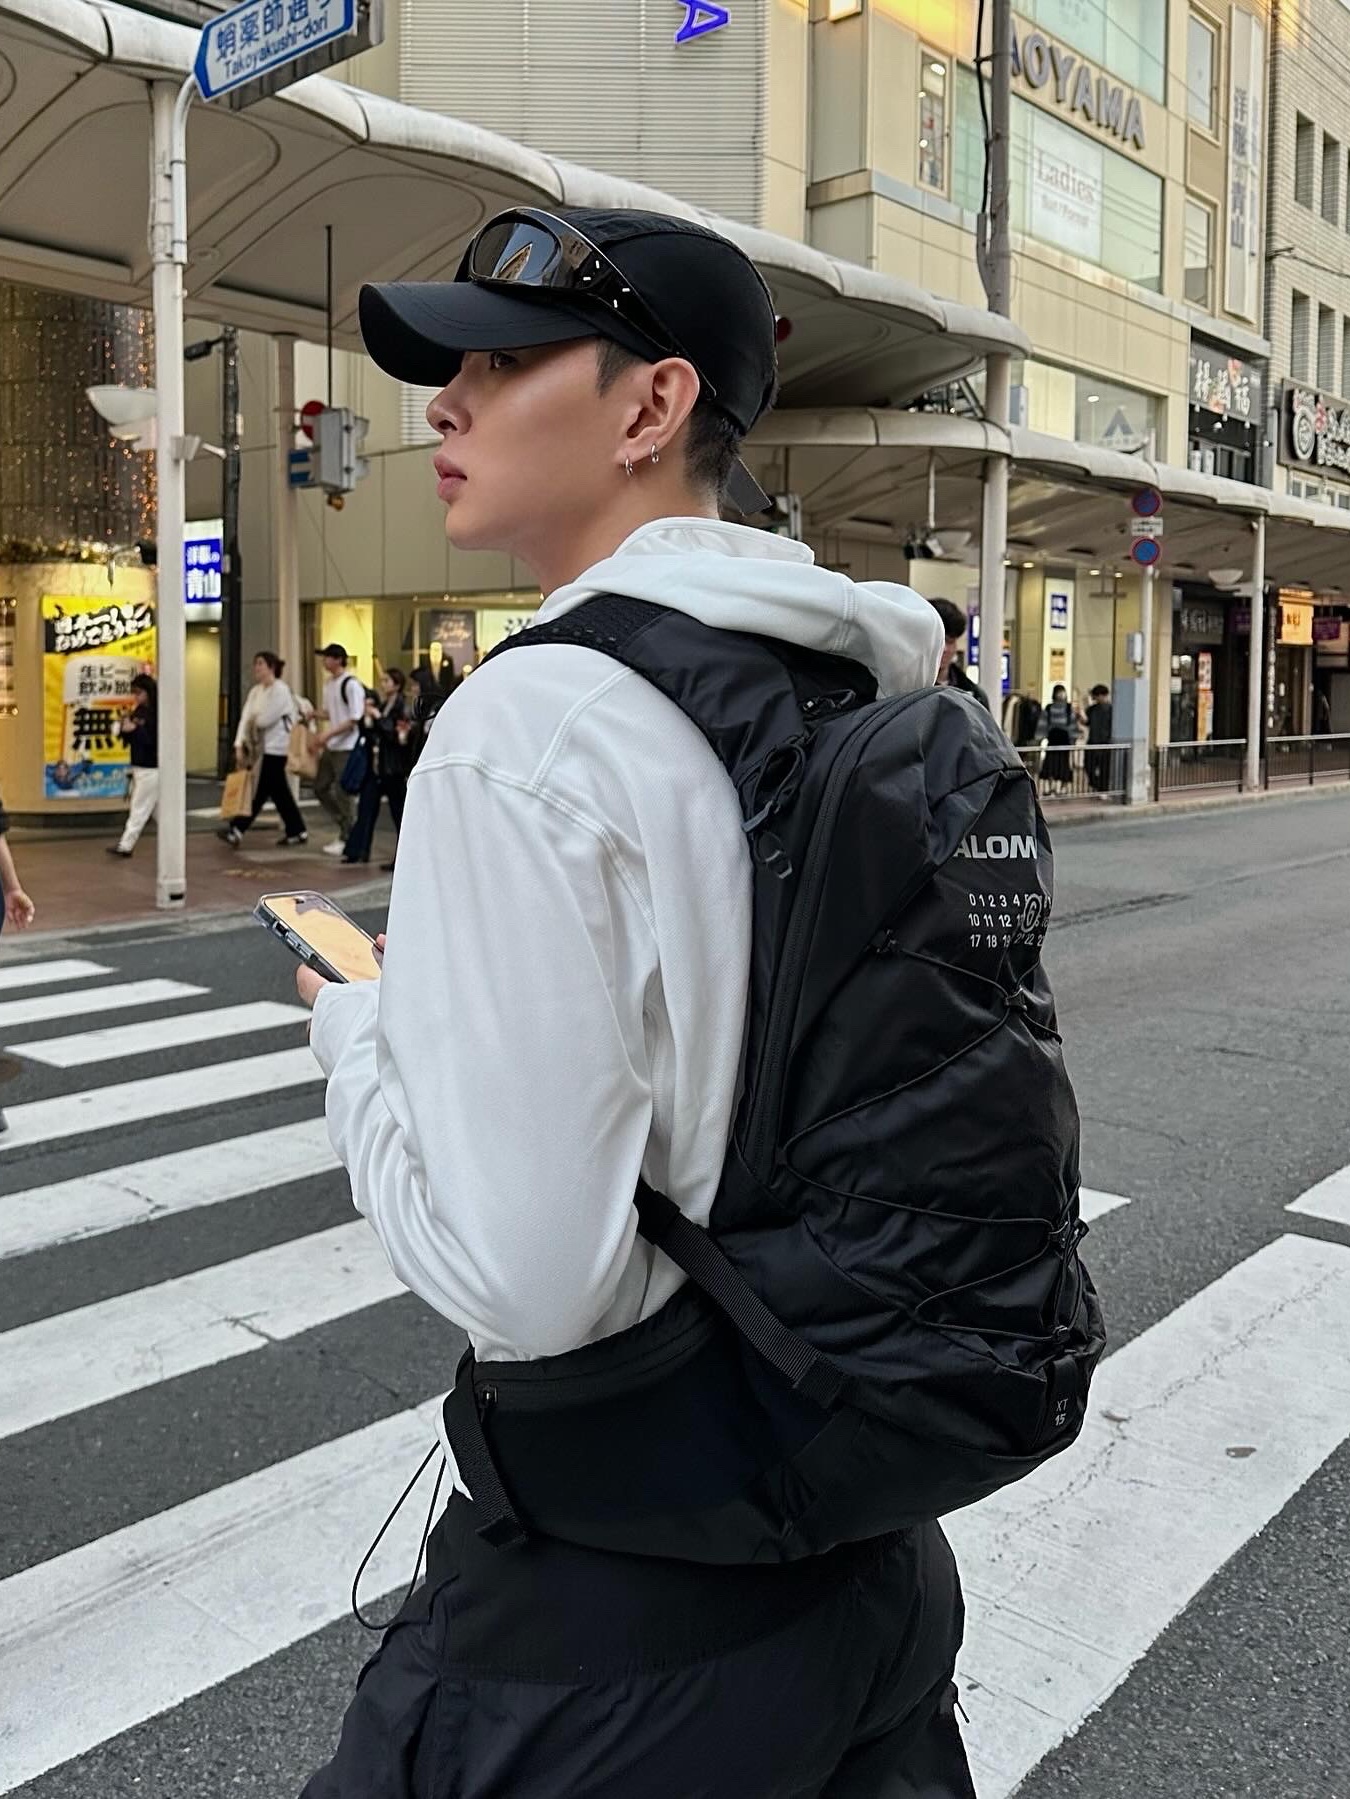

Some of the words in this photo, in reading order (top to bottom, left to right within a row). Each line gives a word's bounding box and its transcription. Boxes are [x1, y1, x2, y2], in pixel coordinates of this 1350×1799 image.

[674, 0, 731, 43] A
[225, 11, 328, 79] Takoyakushi-dori
[187, 568, 221, 599] 青山
[969, 893, 976, 907] 0
[979, 894, 985, 907] 1
[988, 894, 996, 908] 2
[999, 894, 1007, 908] 3
[1013, 894, 1020, 907] 4
[968, 912, 980, 927] 10
[983, 913, 994, 928] 11
[998, 914, 1012, 928] 12
[970, 934, 981, 948] 17
[986, 934, 998, 949] 18
[1056, 1398, 1069, 1412] XT
[1055, 1413, 1067, 1426] 15
